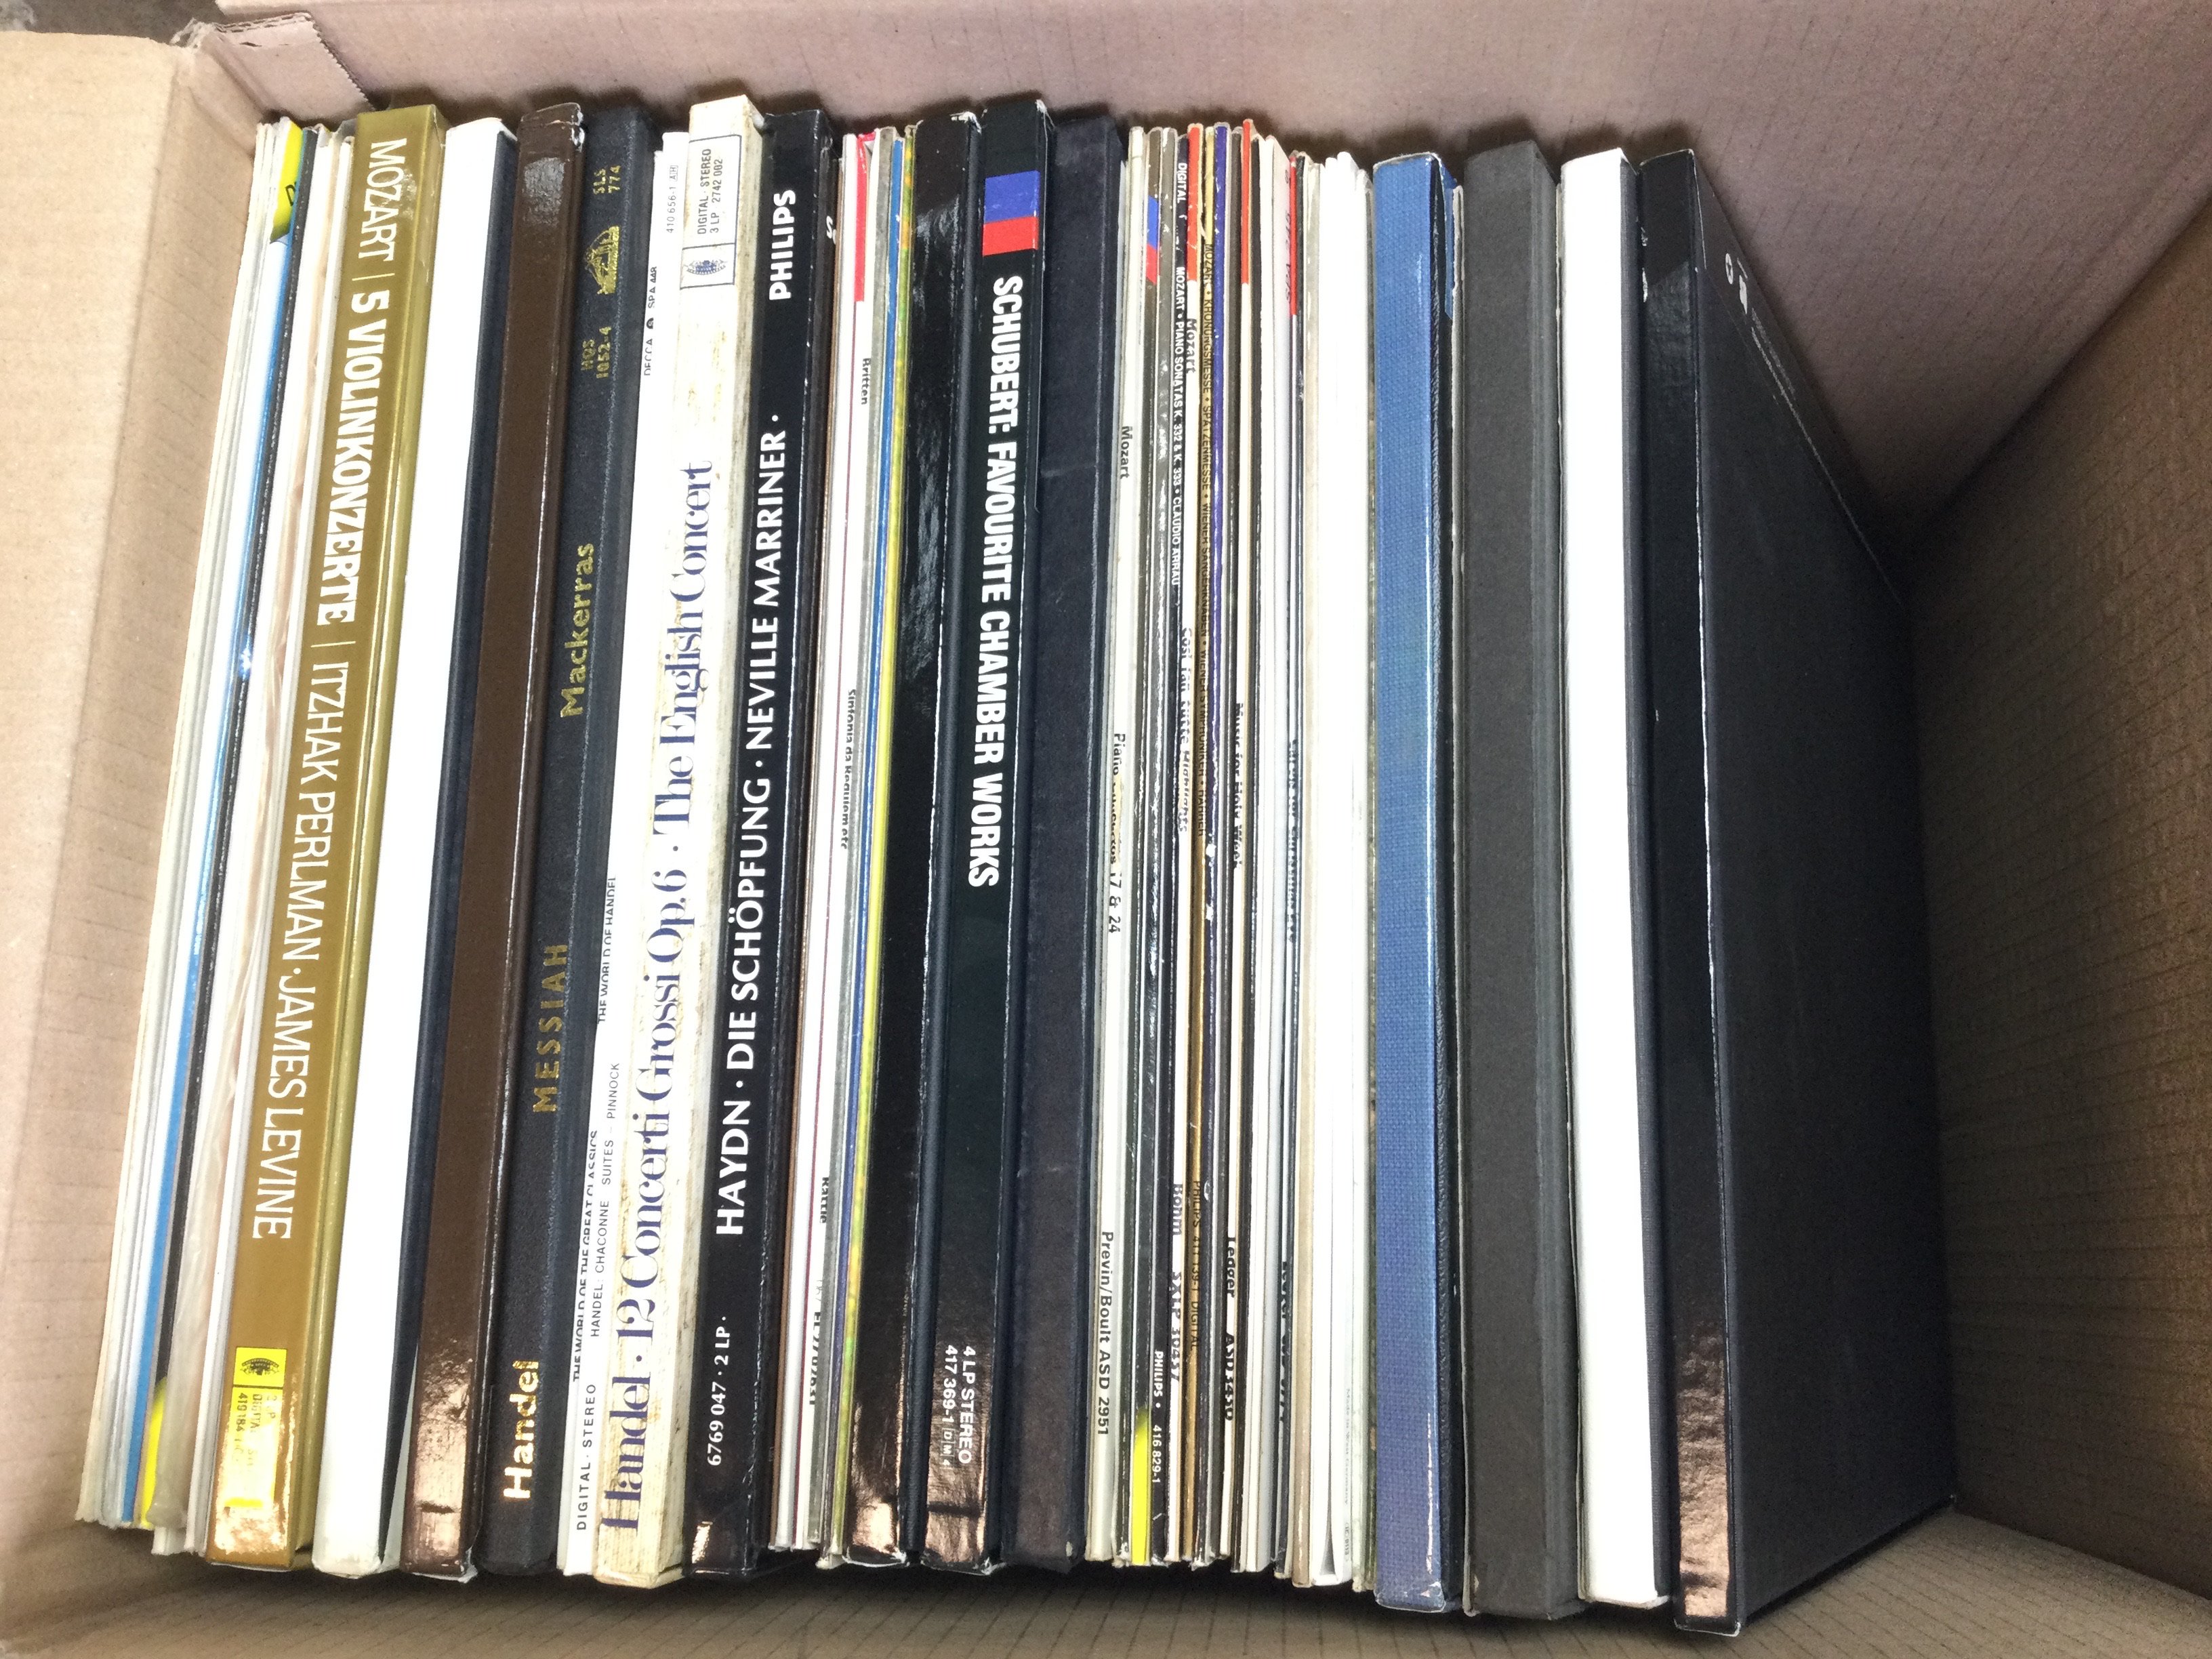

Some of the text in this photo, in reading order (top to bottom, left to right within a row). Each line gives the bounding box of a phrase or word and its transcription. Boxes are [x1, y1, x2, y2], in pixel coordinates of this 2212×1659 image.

[592, 168, 607, 194] SLS
[609, 165, 621, 194] 774
[697, 148, 712, 234] DIGITAL STEREO
[712, 179, 722, 203] 2742
[713, 158, 722, 176] 002
[1177, 162, 1187, 204] DIGITAL
[665, 216, 675, 234] 410
[668, 186, 676, 213] 656-1
[711, 212, 720, 224] LP
[769, 189, 796, 301] PHILIPS
[1175, 266, 1185, 310] MOZART
[1174, 321, 1185, 356] PIANO
[1186, 318, 1197, 374] Mozart
[861, 358, 872, 405] Britten
[1174, 356, 1185, 409] SONATAS
[1120, 426, 1134, 480] Mozart
[1173, 424, 1183, 442] 332
[1172, 467, 1182, 487] 333
[668, 459, 712, 602] Concert
[1171, 496, 1182, 546] CLAUDIO
[968, 274, 1024, 888] SCHUBERT: FAVOURITE CHAMBER WORKS
[559, 543, 595, 718] Mackerras
[251, 138, 407, 1239] MOZART 5 VIOLINKONZERTE ITZHAK PERLMAN JAMES LEVINE
[659, 611, 710, 745] English
[1113, 733, 1126, 776] Piano
[652, 755, 693, 836] The
[715, 430, 786, 1235] HAYDN DIE SCHÖPFUNG NEVILLE MARRINER
[1108, 915, 1121, 934] 24
[1109, 895, 1121, 909] &
[531, 943, 569, 1113] MESSIAH
[634, 972, 681, 1101] Grossi
[606, 1063, 619, 1120] PINNOCK
[601, 1139, 614, 1185] SUITES
[619, 1110, 670, 1289] Concerti
[594, 1200, 610, 1273] CHACONNE
[1099, 1231, 1114, 1343] Previn/Boult
[615, 1298, 655, 1343] 12
[945, 1344, 958, 1374] 417
[1098, 1349, 1111, 1390] ASD
[707, 1326, 731, 1467] 6769 047 2 LP
[942, 1377, 957, 1423] 369-1
[958, 1345, 976, 1464] 4 LP STEREO
[1097, 1396, 1110, 1435] 2951
[1152, 1350, 1164, 1483] PHILIPS 416 829-1
[503, 1359, 540, 1500] Handel
[600, 1372, 652, 1536] Handel
[576, 1383, 596, 1531] DIGITAL STEREO
